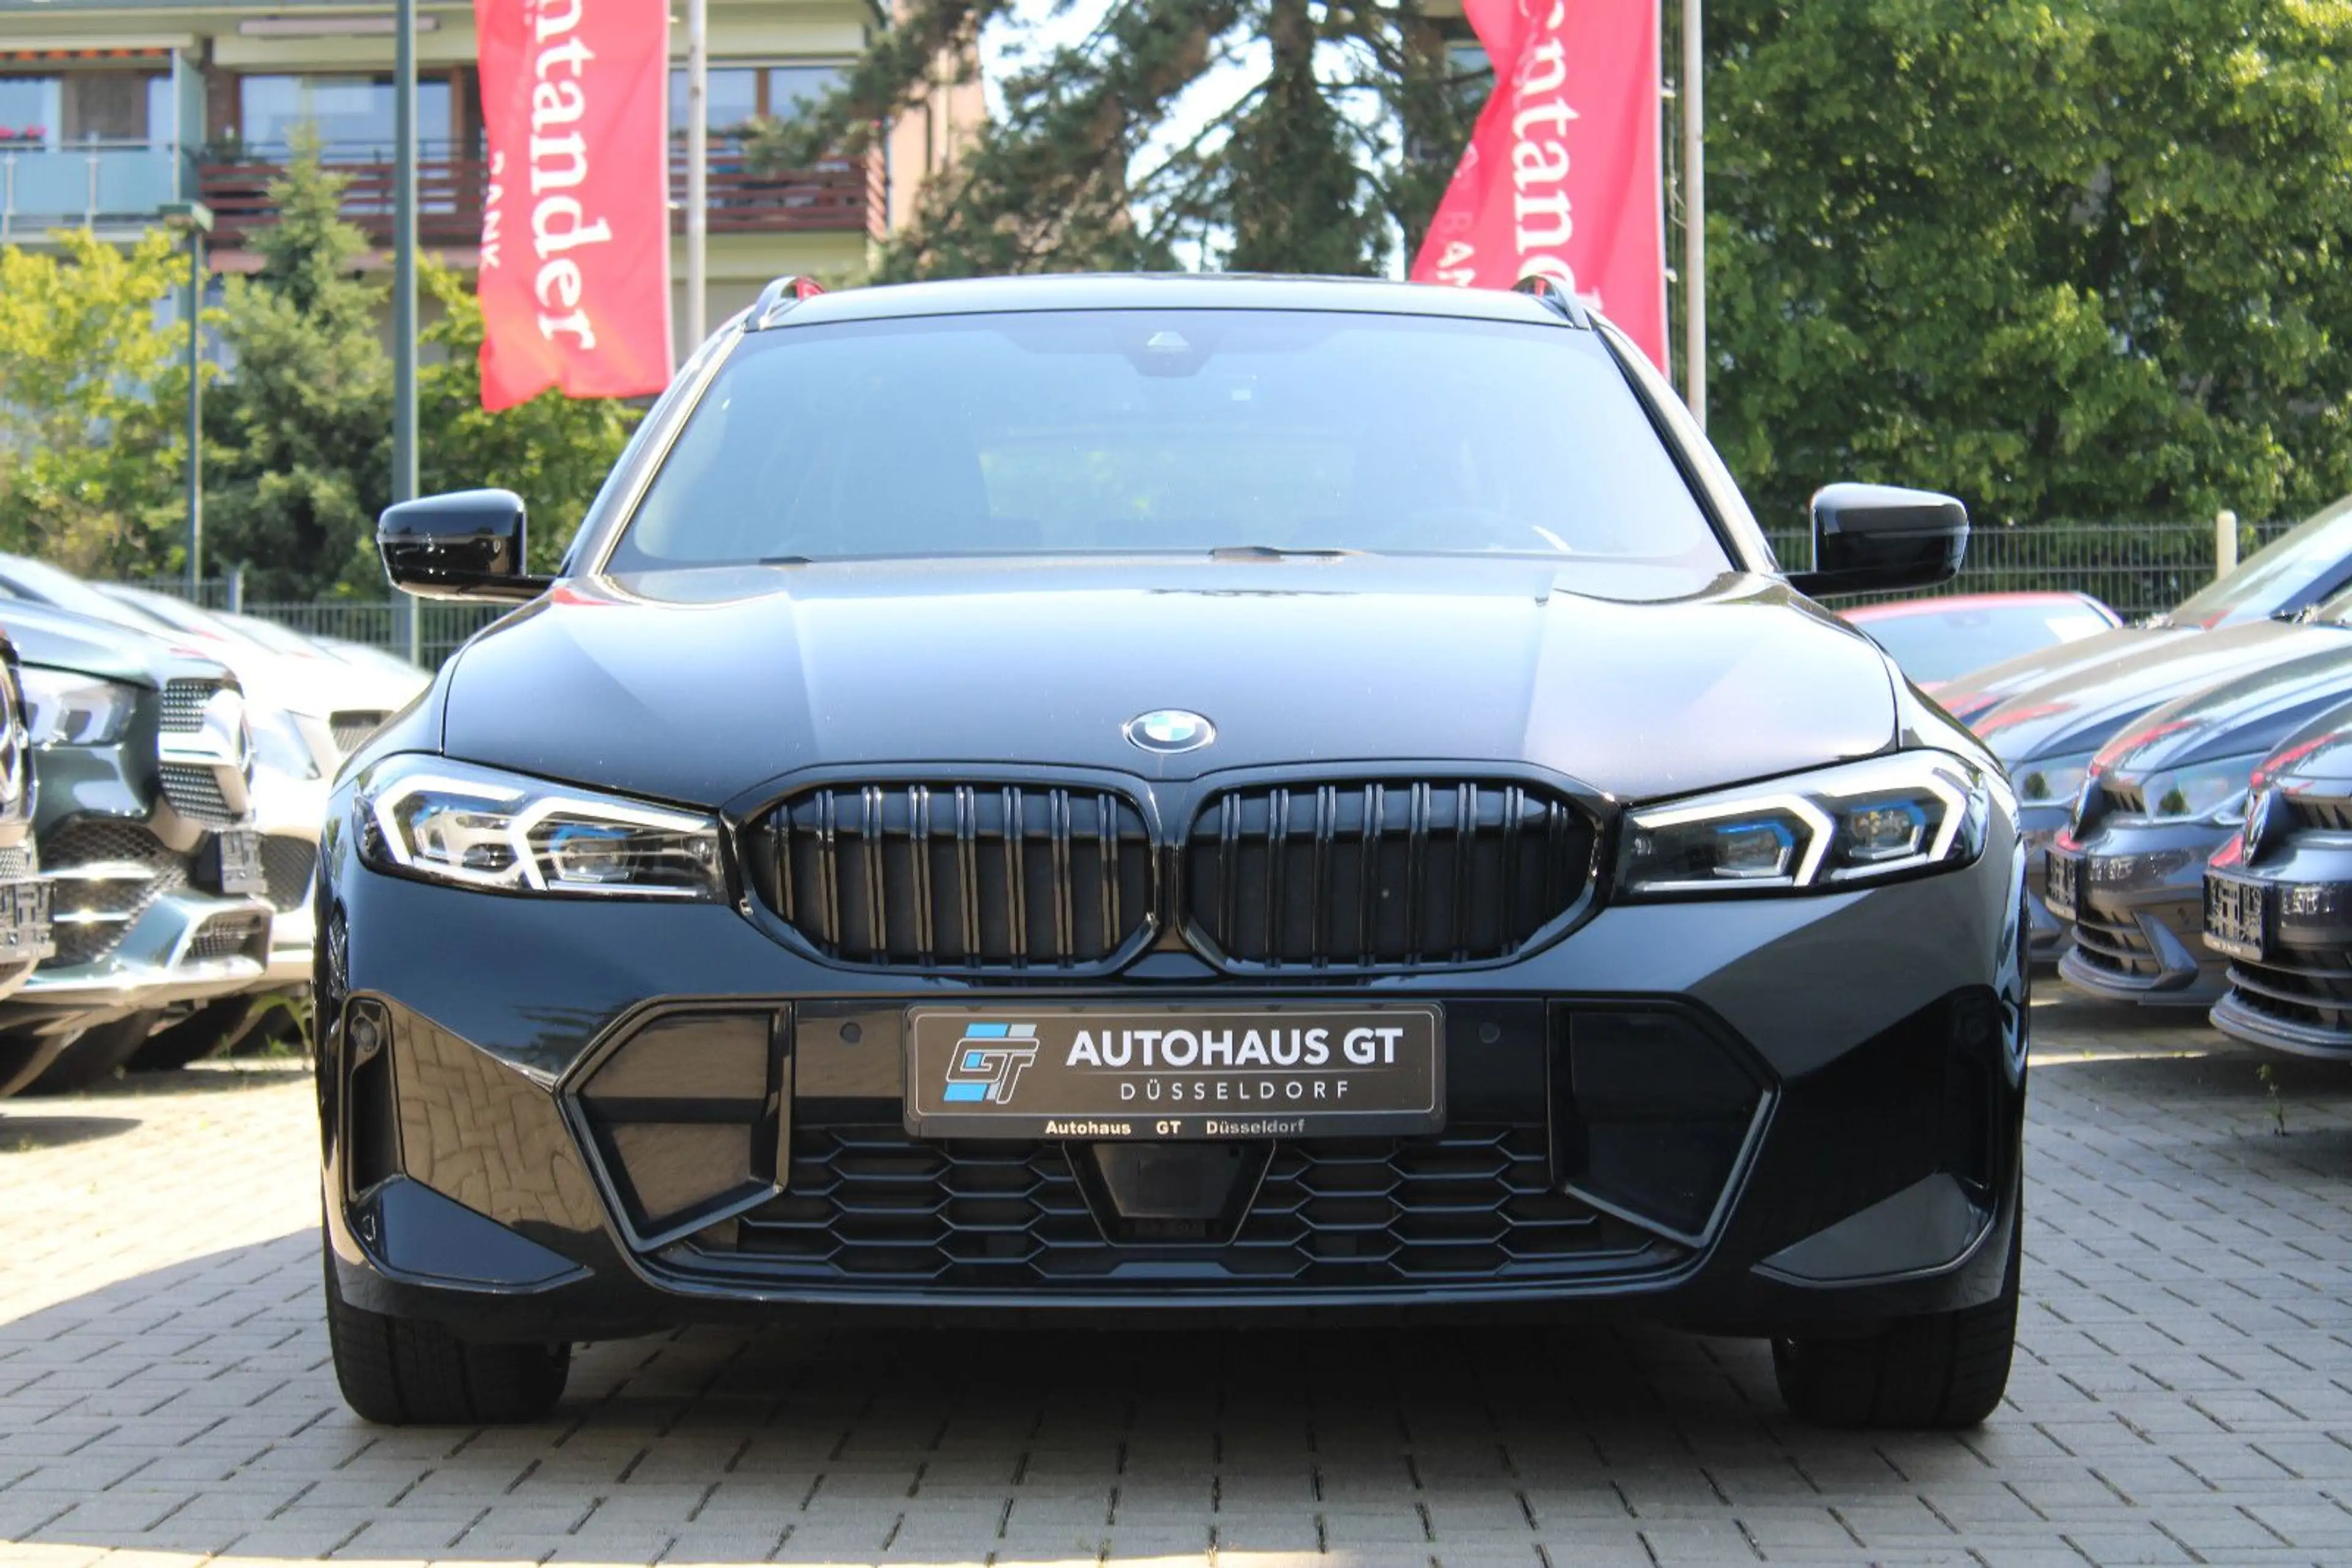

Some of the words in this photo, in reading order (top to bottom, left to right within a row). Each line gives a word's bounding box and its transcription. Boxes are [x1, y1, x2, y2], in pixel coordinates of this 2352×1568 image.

[1065, 1028, 1330, 1067] AUTOHAUS
[1343, 1027, 1403, 1065] GT
[1120, 1079, 1348, 1101] DÜSSELDORF
[1044, 1120, 1132, 1135] Autohaus
[1156, 1120, 1182, 1135] GT
[1206, 1118, 1306, 1135] Düsseldorf
